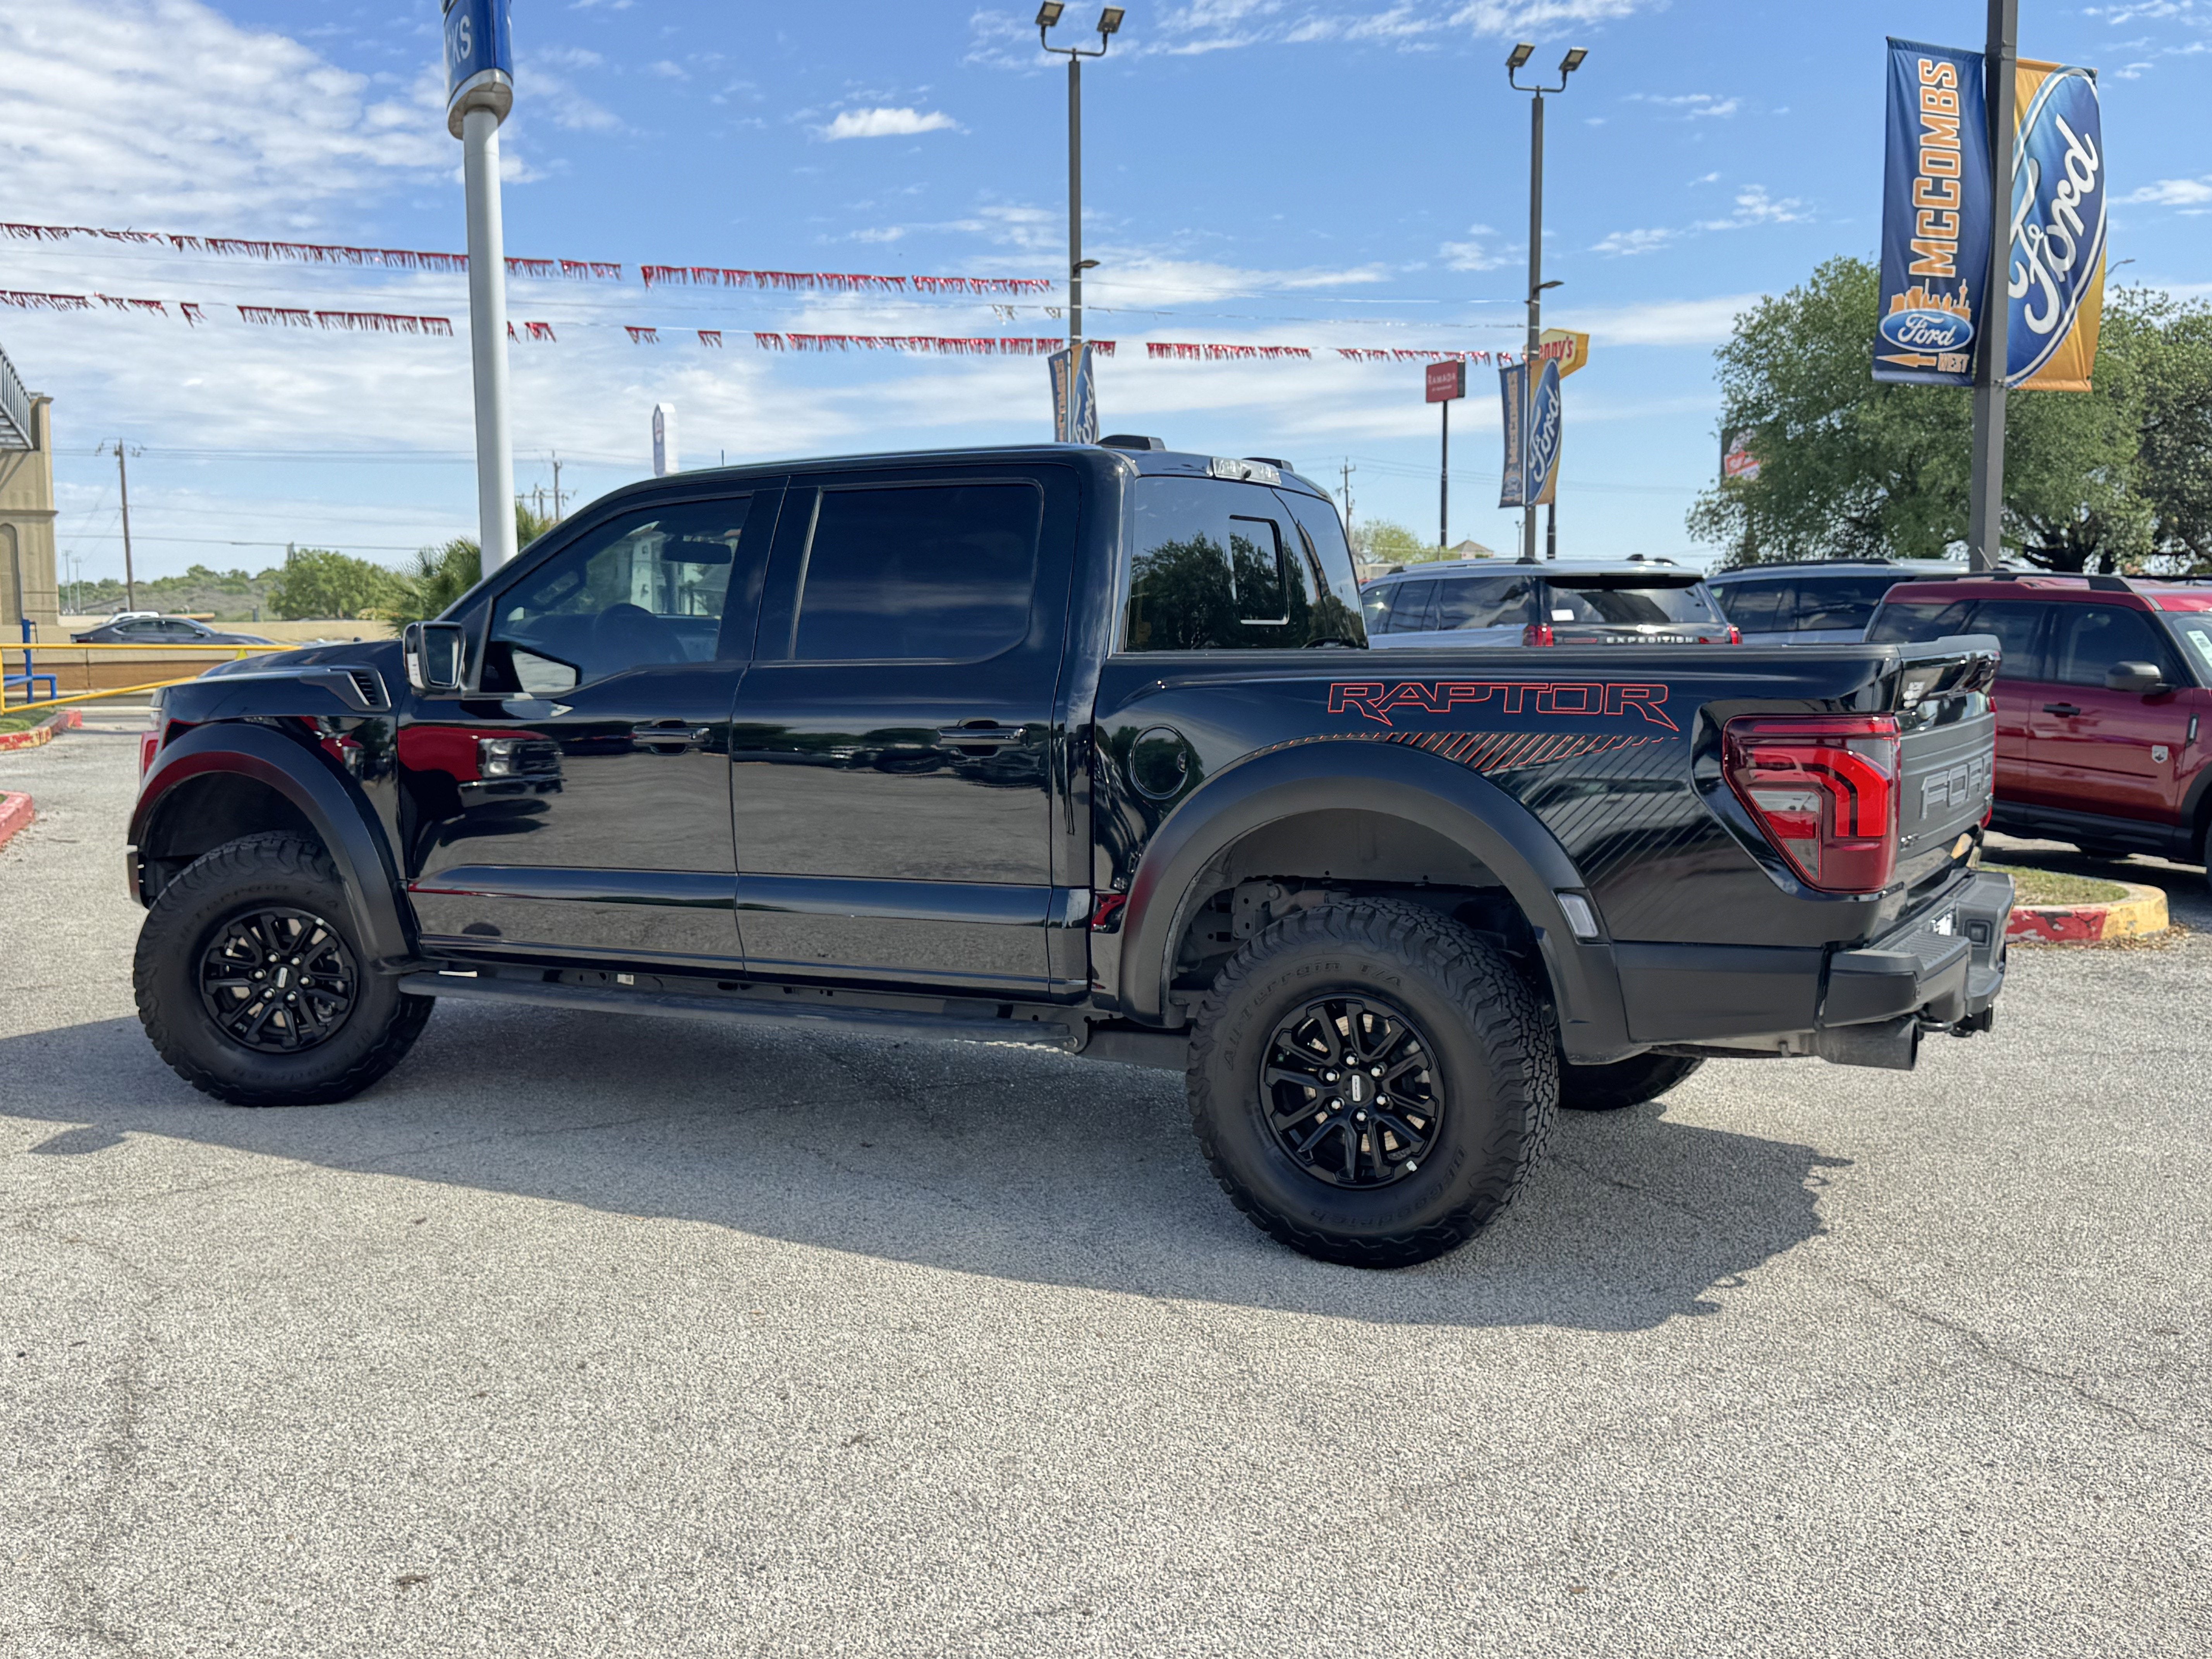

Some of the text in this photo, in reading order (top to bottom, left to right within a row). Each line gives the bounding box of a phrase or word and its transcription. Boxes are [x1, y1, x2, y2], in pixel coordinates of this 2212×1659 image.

[2008, 113, 2099, 334] Ford
[1539, 335, 1574, 361] enny's
[1898, 313, 1957, 346] Ford
[1937, 353, 1970, 373] WEST
[1528, 385, 1559, 483] Ford
[1328, 682, 1680, 732] RAPTOR
[1919, 750, 1993, 821] FORD
